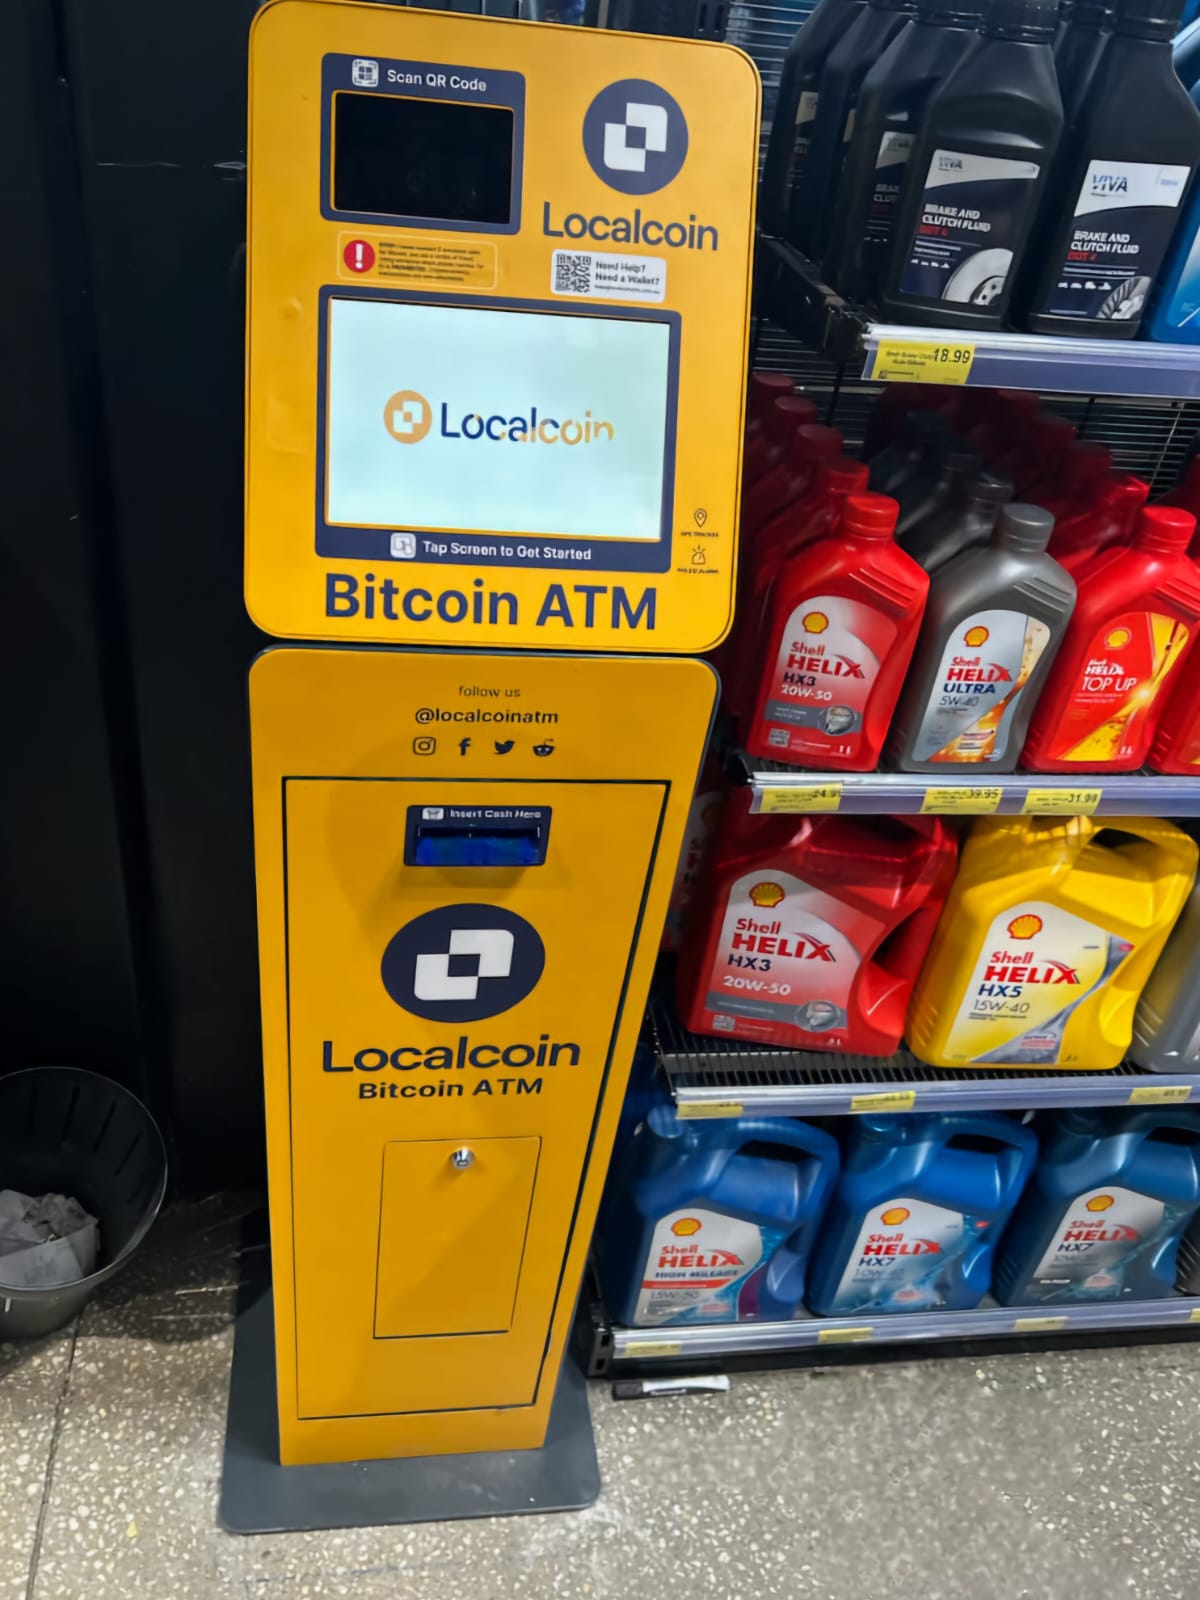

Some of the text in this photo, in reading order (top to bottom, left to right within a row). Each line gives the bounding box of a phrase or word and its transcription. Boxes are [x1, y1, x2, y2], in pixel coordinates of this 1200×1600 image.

[387, 69, 487, 91] Scan QR Code
[1091, 173, 1128, 193] VIVA
[924, 203, 981, 220] BRAKE AND
[543, 201, 718, 252] Localcoin
[922, 214, 992, 233] CLUTCH FLUID
[1073, 230, 1131, 243] BRAKE AND
[1070, 241, 1140, 255] CLUTCH FLUID
[595, 272, 660, 286] Need a Wallet?
[934, 347, 971, 364] 18.99
[440, 402, 615, 446] Localcoin
[423, 540, 592, 561] Tap Screen to Get Started
[325, 572, 657, 631] Bitcoin ATM
[790, 641, 826, 657] Shell
[786, 653, 865, 679] HELIX
[952, 656, 981, 666] Shell
[1084, 661, 1125, 676] HELIX
[783, 672, 817, 687] HX3
[946, 663, 1013, 682] HELIX
[458, 685, 521, 698] follow us
[781, 684, 833, 701] 20W-50
[943, 682, 996, 694] ULTRA
[1082, 676, 1137, 692] TOP UP
[415, 707, 558, 725] @localcoinatm
[450, 808, 542, 819] Insert Cash Here
[735, 917, 781, 935] Shell
[731, 932, 837, 963] HELIX
[727, 953, 772, 972] HX3
[990, 951, 1034, 965] Shell
[983, 959, 1081, 985] HELIX
[723, 975, 792, 996] 20W-50
[977, 983, 1022, 998] HX5
[973, 998, 1030, 1014] 15W-40
[322, 1034, 581, 1073] Localcoin
[358, 1077, 543, 1100] Bitcoin ATM
[1063, 1224, 1140, 1242] HELIX
[1069, 1219, 1106, 1230] Shell
[863, 1238, 944, 1256] HELIX
[868, 1233, 904, 1244] Shell
[661, 1243, 699, 1256] Shell
[1057, 1242, 1095, 1253] HX7
[657, 1249, 745, 1269] HELIX
[858, 1256, 896, 1267] HX7
